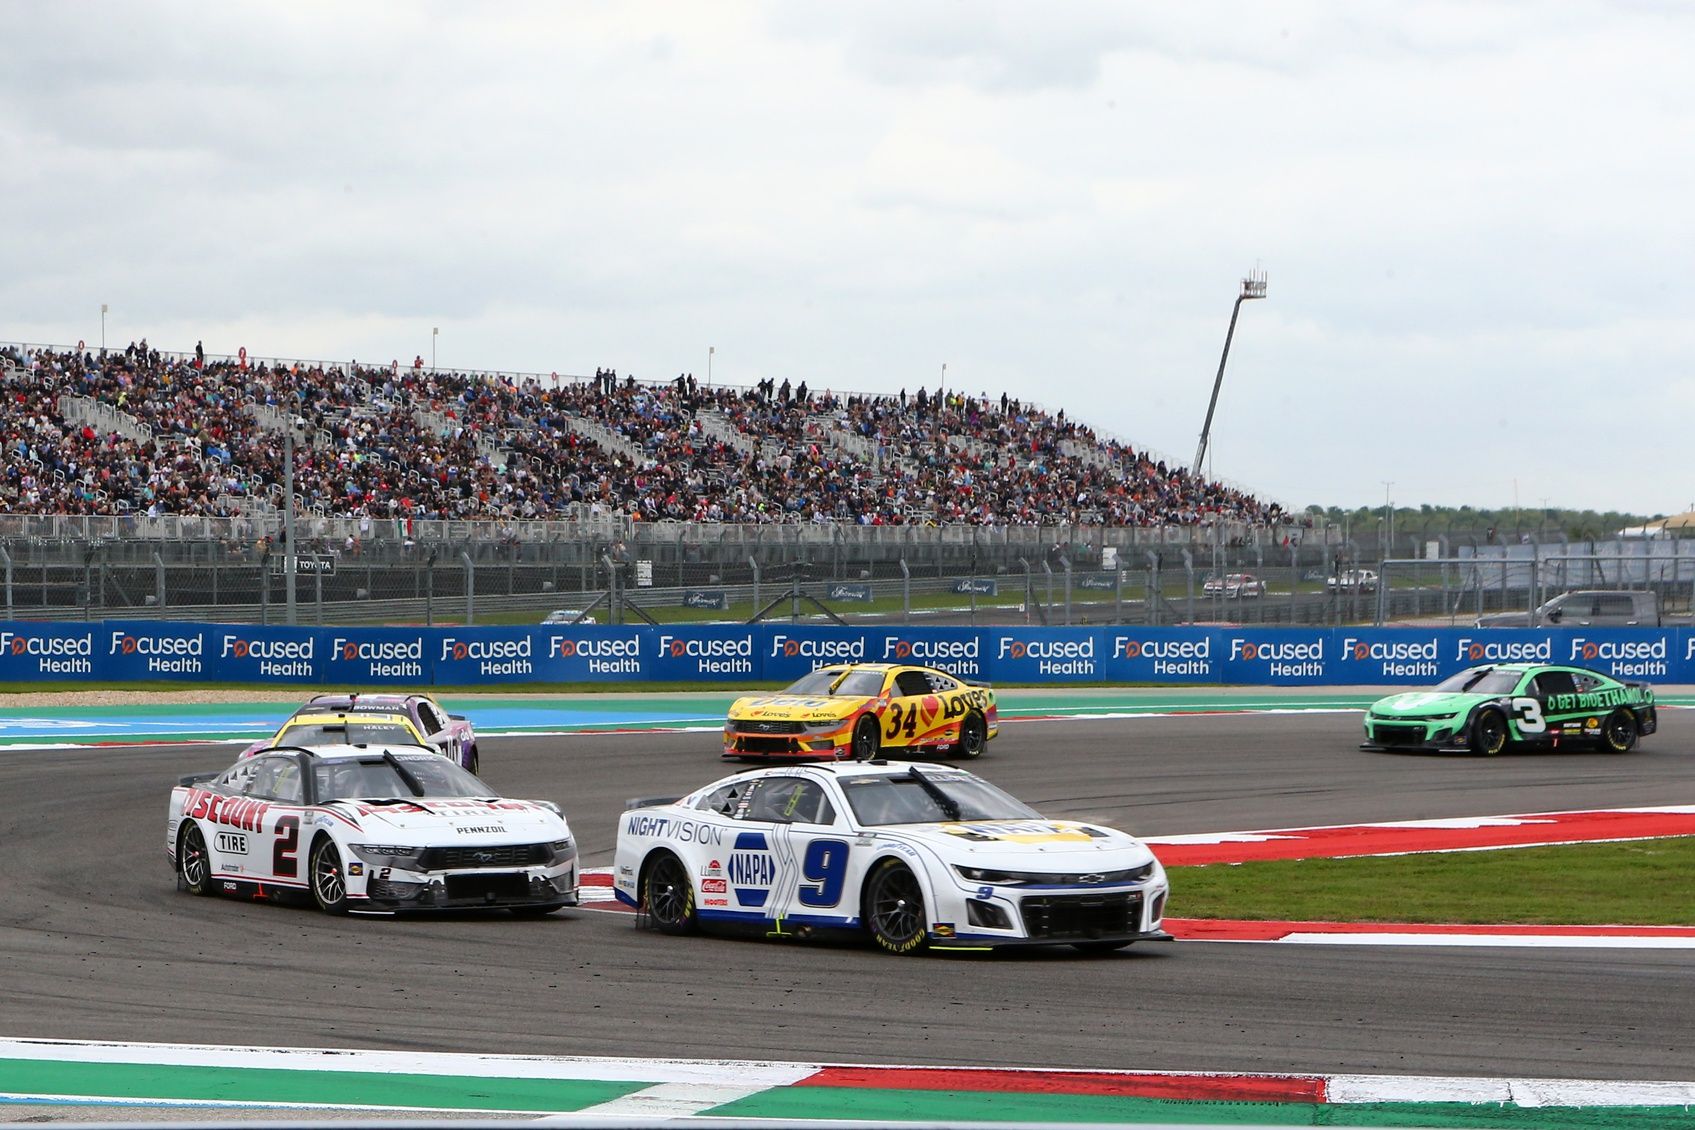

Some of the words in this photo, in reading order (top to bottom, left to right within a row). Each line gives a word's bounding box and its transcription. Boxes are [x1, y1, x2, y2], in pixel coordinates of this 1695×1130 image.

[0, 632, 92, 656] Focused
[109, 631, 203, 656] Focused
[220, 634, 314, 658] Focused
[331, 636, 422, 661] Focused
[440, 638, 531, 661] Focused
[548, 634, 640, 658] Focused
[658, 634, 752, 658] Focused
[770, 635, 865, 658] Focused
[882, 636, 979, 659] Focused
[996, 637, 1094, 660] Focused
[1112, 636, 1209, 660] Focused
[1229, 638, 1323, 661] Focused
[1341, 638, 1437, 661] Focused
[1455, 637, 1551, 661] Focused
[1569, 637, 1666, 660] Focused
[39, 657, 92, 673] Health
[147, 657, 202, 673] Health
[260, 660, 314, 676] Health
[370, 661, 422, 676] Health
[481, 659, 532, 675] Health
[589, 658, 640, 674] Health
[698, 658, 752, 674] Health
[1039, 660, 1094, 675] Health
[1154, 660, 1209, 675] Health
[1270, 660, 1323, 676] Health
[1383, 661, 1437, 676] Health
[1611, 660, 1666, 676] Health
[353, 704, 401, 712] BOWMAN
[1557, 693, 1577, 711] GET
[885, 702, 918, 740] 34
[1511, 697, 1547, 733] 3
[363, 724, 396, 732] HALEY
[456, 826, 508, 835] PENNZOIL
[219, 834, 247, 852] TIRE
[272, 814, 301, 878] 2
[380, 868, 392, 879] 2
[736, 853, 769, 885] NAPA
[798, 838, 850, 909] 9
[976, 886, 994, 900] 9
